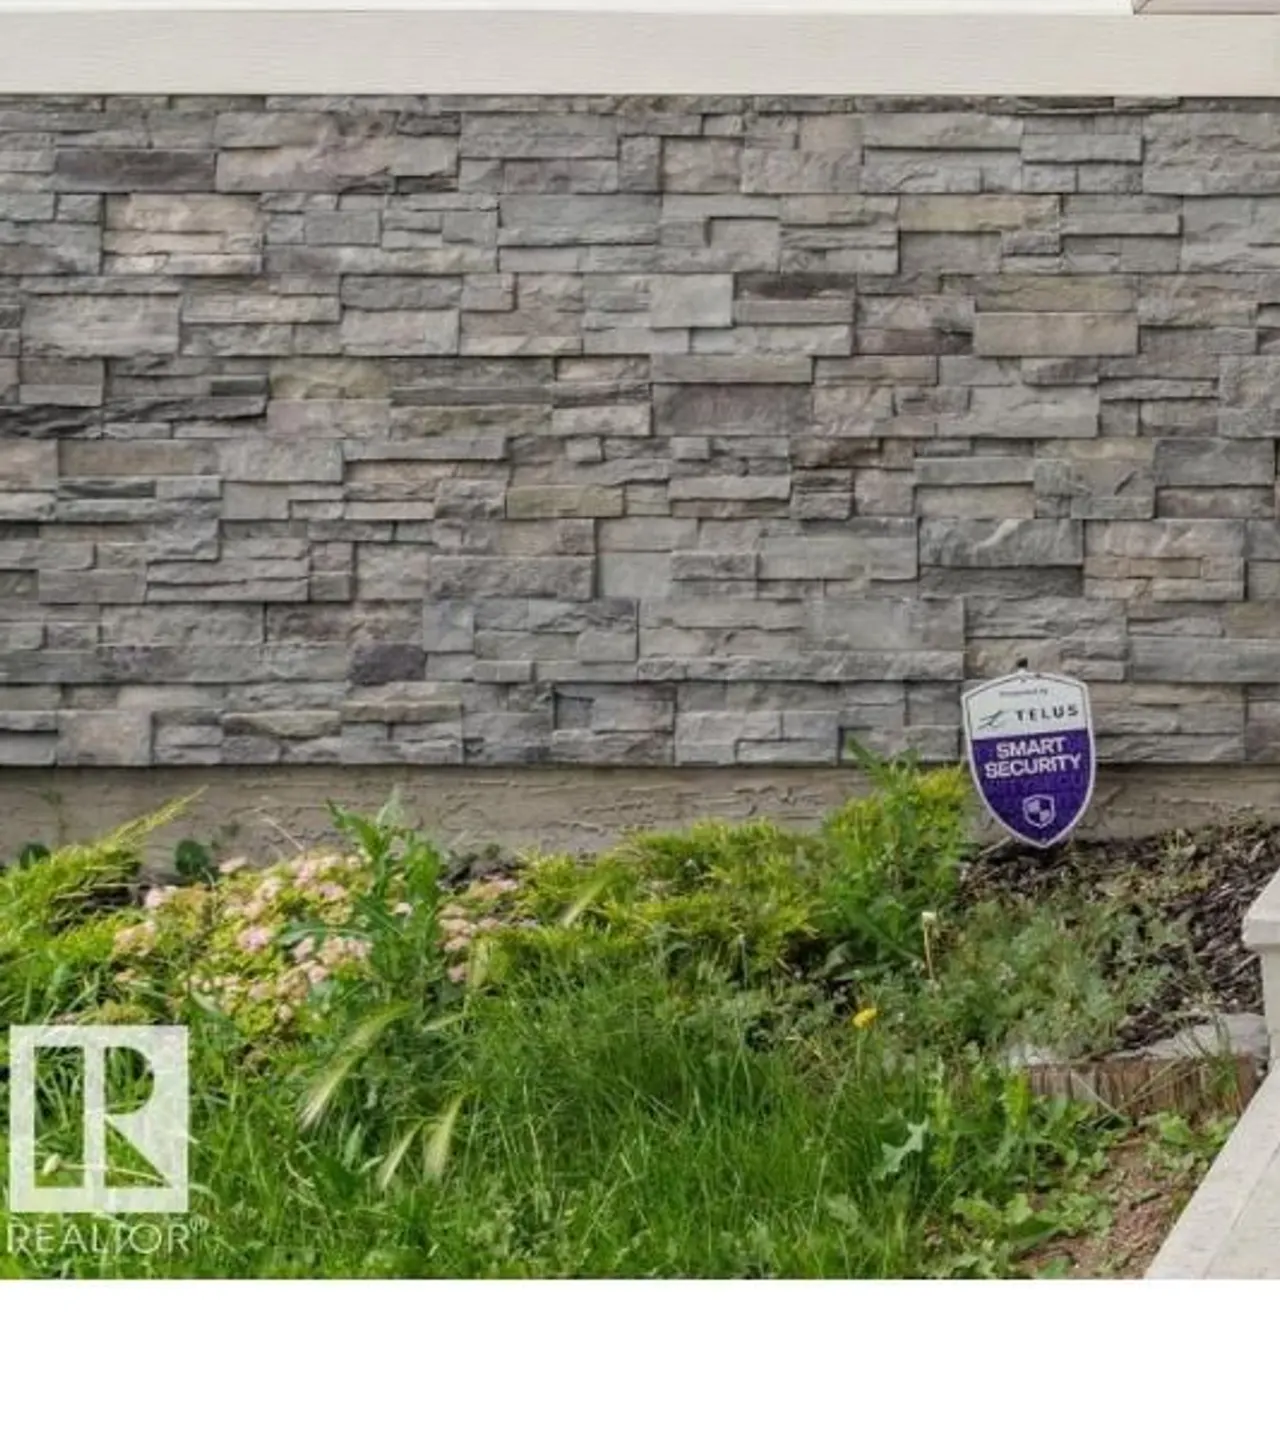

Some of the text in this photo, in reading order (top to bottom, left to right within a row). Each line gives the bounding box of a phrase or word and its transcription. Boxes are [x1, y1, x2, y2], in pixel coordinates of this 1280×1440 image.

[1016, 703, 1079, 722] TELUS
[996, 736, 1067, 760] SMART
[984, 752, 1082, 779] SECURITY
